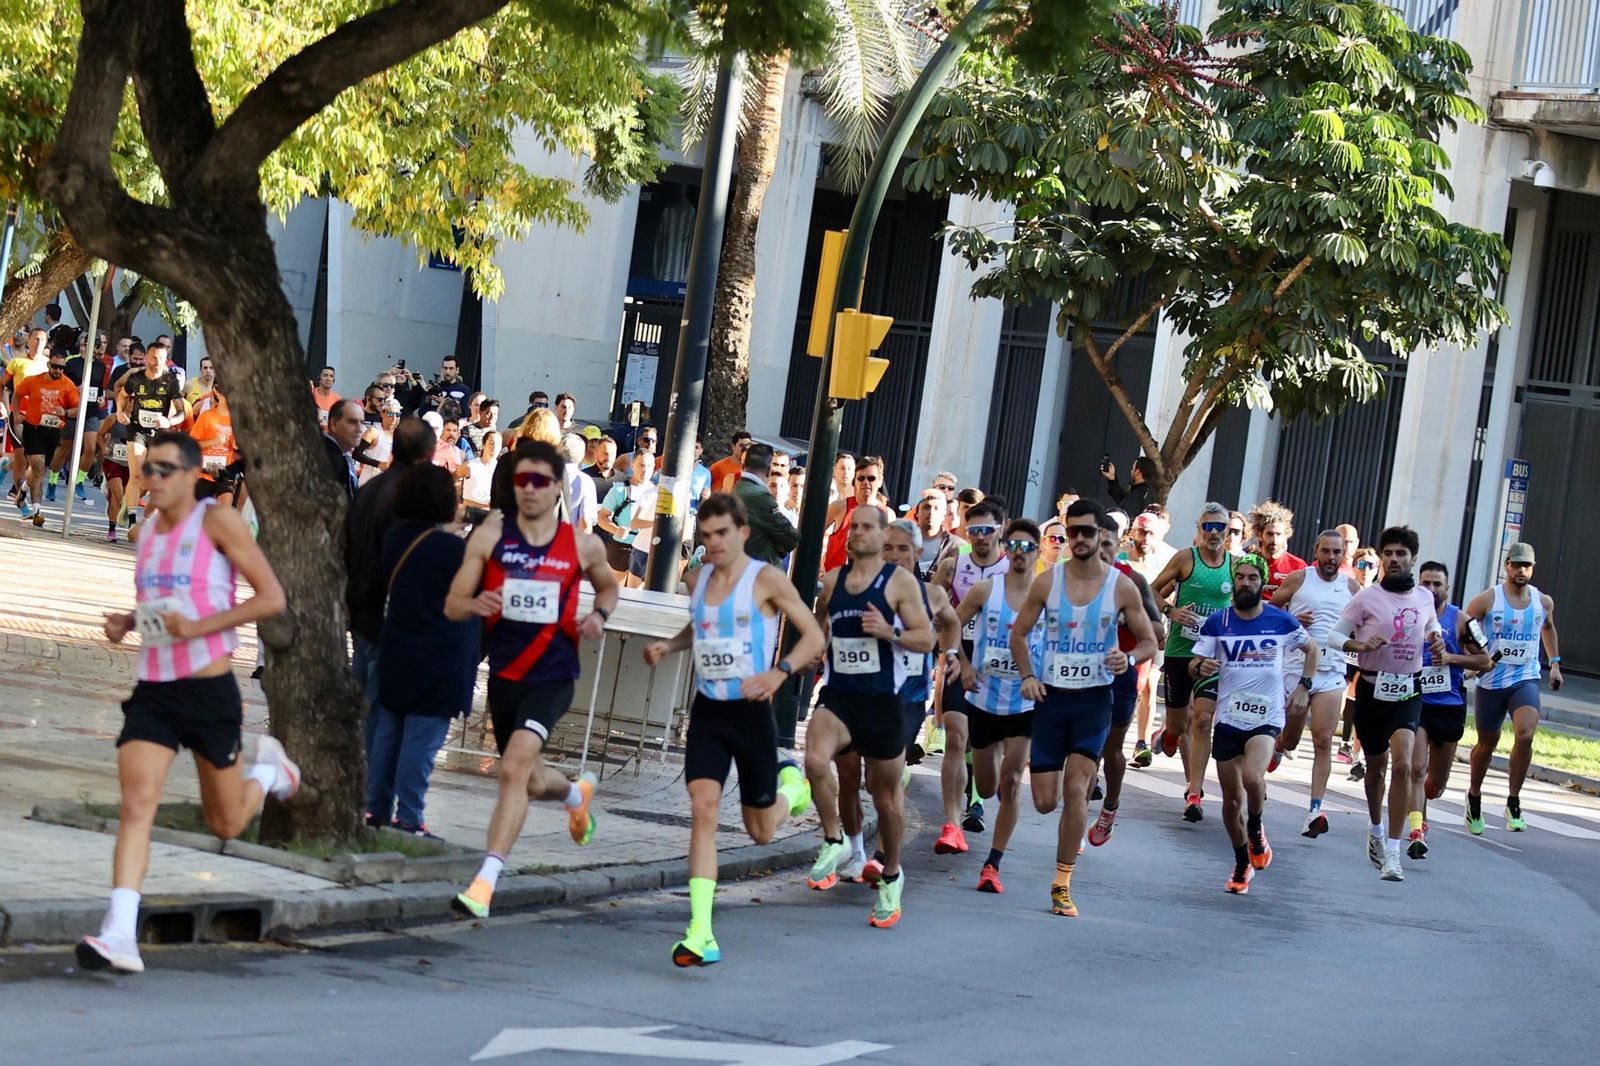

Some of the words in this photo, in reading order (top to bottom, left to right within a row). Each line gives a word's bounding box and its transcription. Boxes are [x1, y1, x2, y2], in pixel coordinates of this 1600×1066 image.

[1512, 463, 1529, 478] BUS
[510, 594, 547, 609] 694
[1220, 638, 1278, 662] VAS
[1503, 647, 1526, 658] 947
[701, 653, 734, 667] 330
[839, 651, 870, 663] 390
[991, 658, 1018, 671] 312
[1060, 665, 1091, 678] 870
[1420, 674, 1445, 686] 448
[1381, 682, 1408, 694] 324
[1234, 701, 1267, 715] 1029
